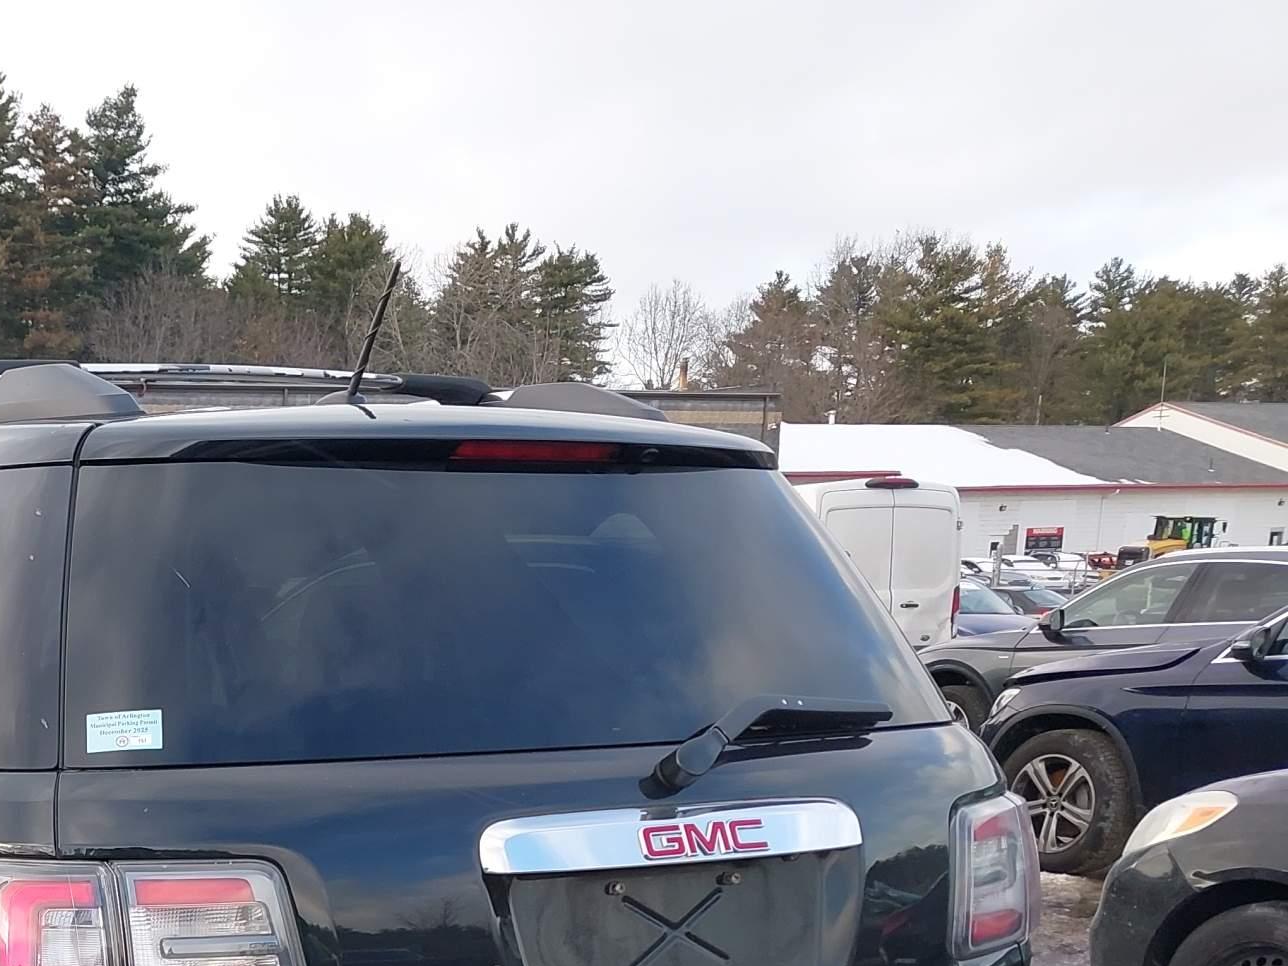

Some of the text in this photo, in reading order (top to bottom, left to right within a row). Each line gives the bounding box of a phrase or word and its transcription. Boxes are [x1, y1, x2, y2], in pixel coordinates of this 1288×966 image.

[122, 712, 150, 720] Arlington
[99, 728, 131, 736] December
[641, 818, 770, 859] GMC
